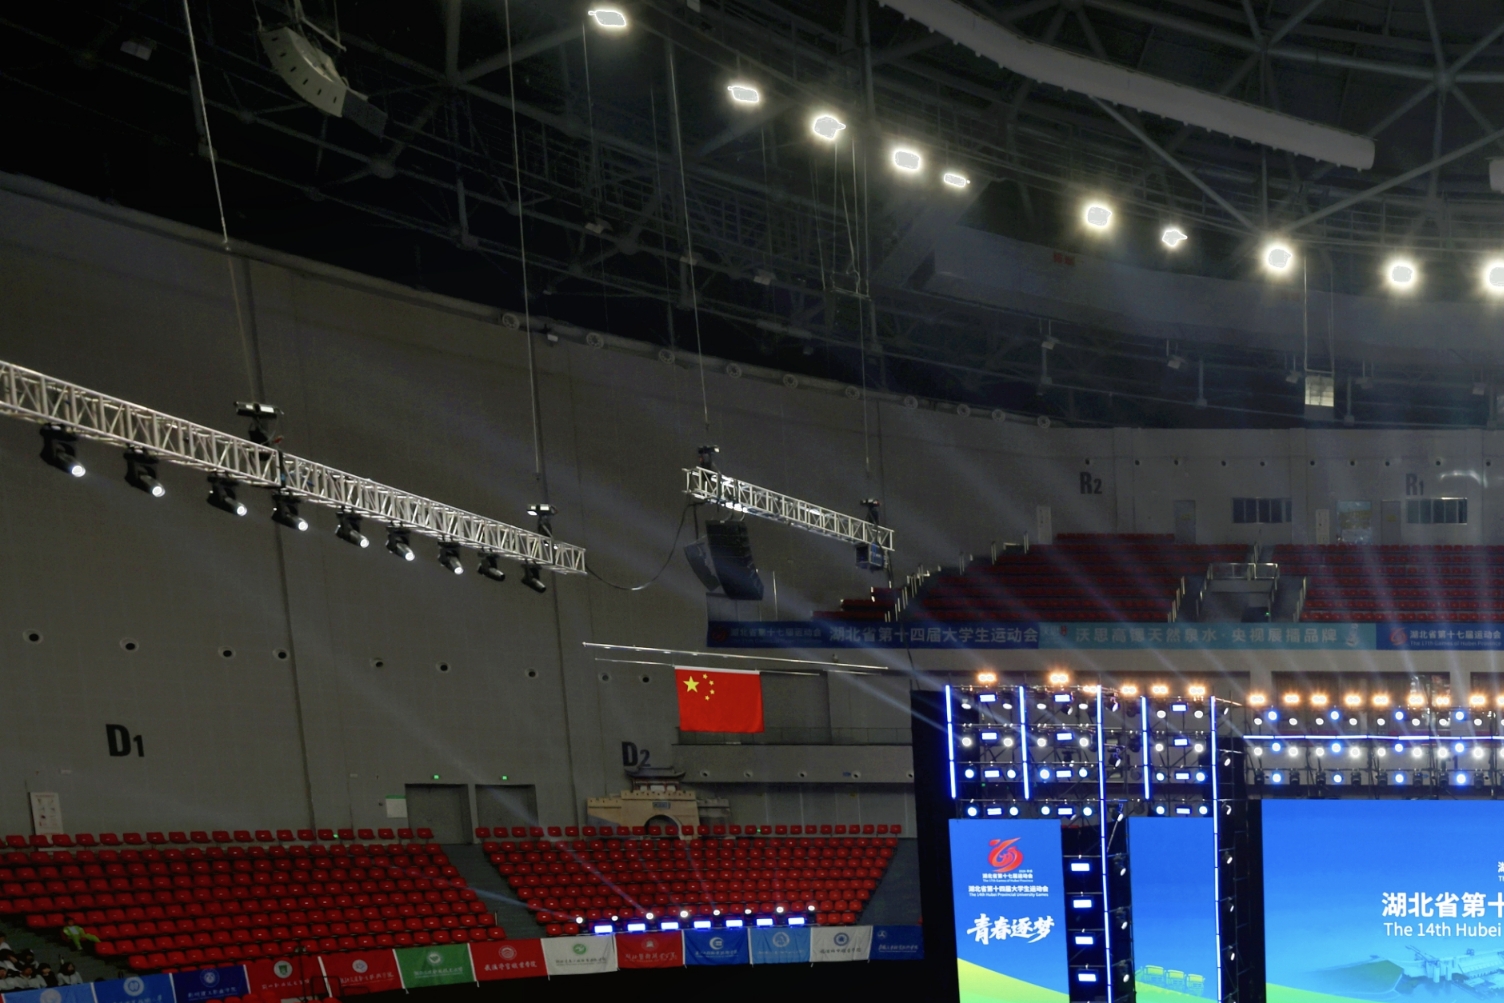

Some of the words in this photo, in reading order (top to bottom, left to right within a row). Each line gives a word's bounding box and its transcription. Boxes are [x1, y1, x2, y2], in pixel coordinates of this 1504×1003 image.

[1080, 472, 1102, 494] R2
[1406, 473, 1424, 495] R1
[829, 626, 1039, 643] 湖北省第十四届大学生运动会
[1410, 630, 1501, 639] 湖北省第十七届运动会
[105, 724, 145, 757] D1
[621, 741, 651, 767] D2
[968, 885, 1049, 893] 湖北省第十四届大学生运动会
[966, 913, 1055, 945] 青春逐梦
[1383, 922, 1413, 938] The
[1417, 922, 1452, 938] 14th
[1455, 922, 1502, 938] Hubei
